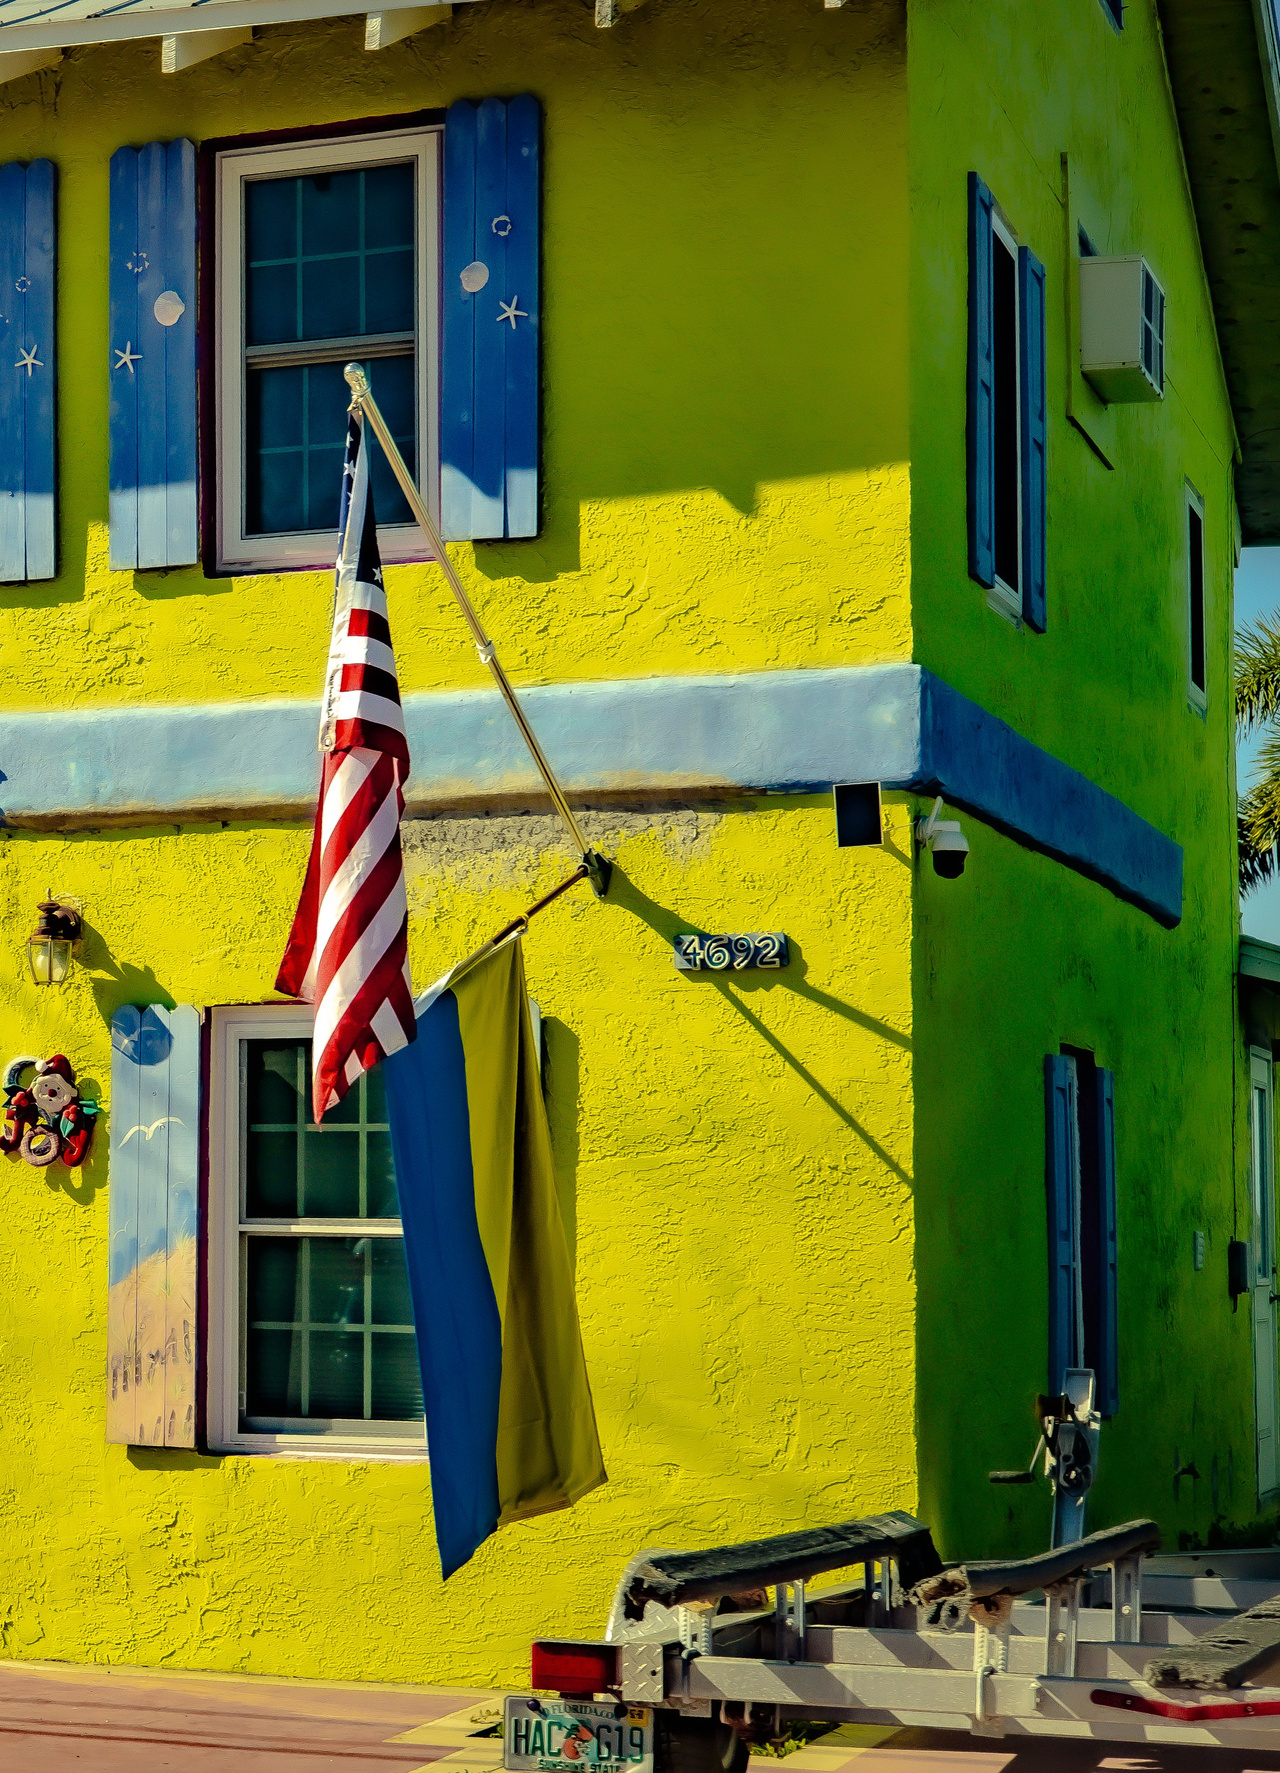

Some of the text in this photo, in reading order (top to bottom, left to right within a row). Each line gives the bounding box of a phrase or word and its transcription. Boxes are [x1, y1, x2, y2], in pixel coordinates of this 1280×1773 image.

[681, 934, 781, 970] 4692
[512, 1717, 644, 1763] HAC G19
